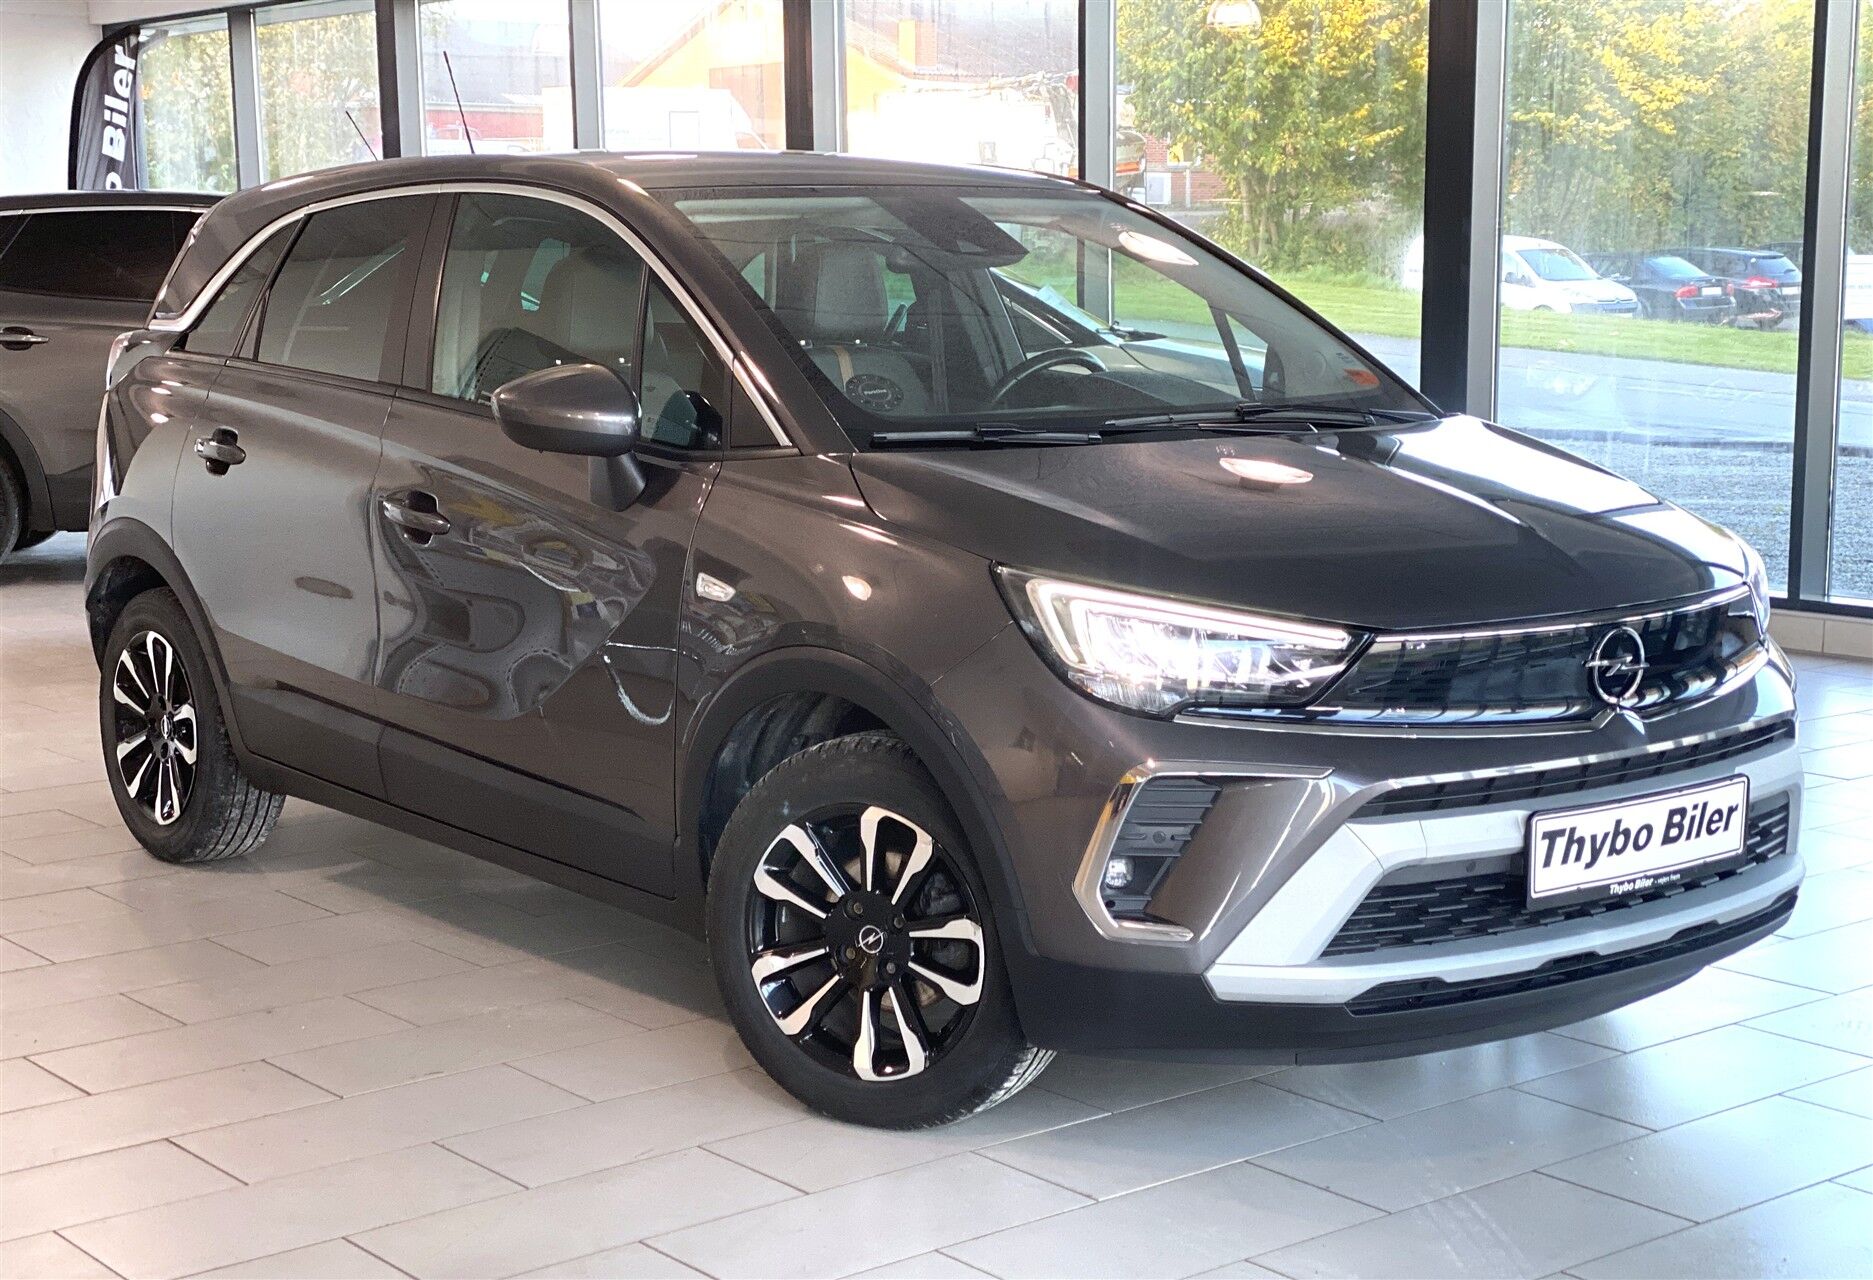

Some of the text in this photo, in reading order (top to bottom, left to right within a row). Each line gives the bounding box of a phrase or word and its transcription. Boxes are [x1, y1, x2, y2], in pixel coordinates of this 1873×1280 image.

[102, 44, 136, 162] Biler
[1541, 801, 1739, 869] Thybo Biler
[1610, 882, 1634, 894] Thybo
[1634, 878, 1654, 889] Biler
